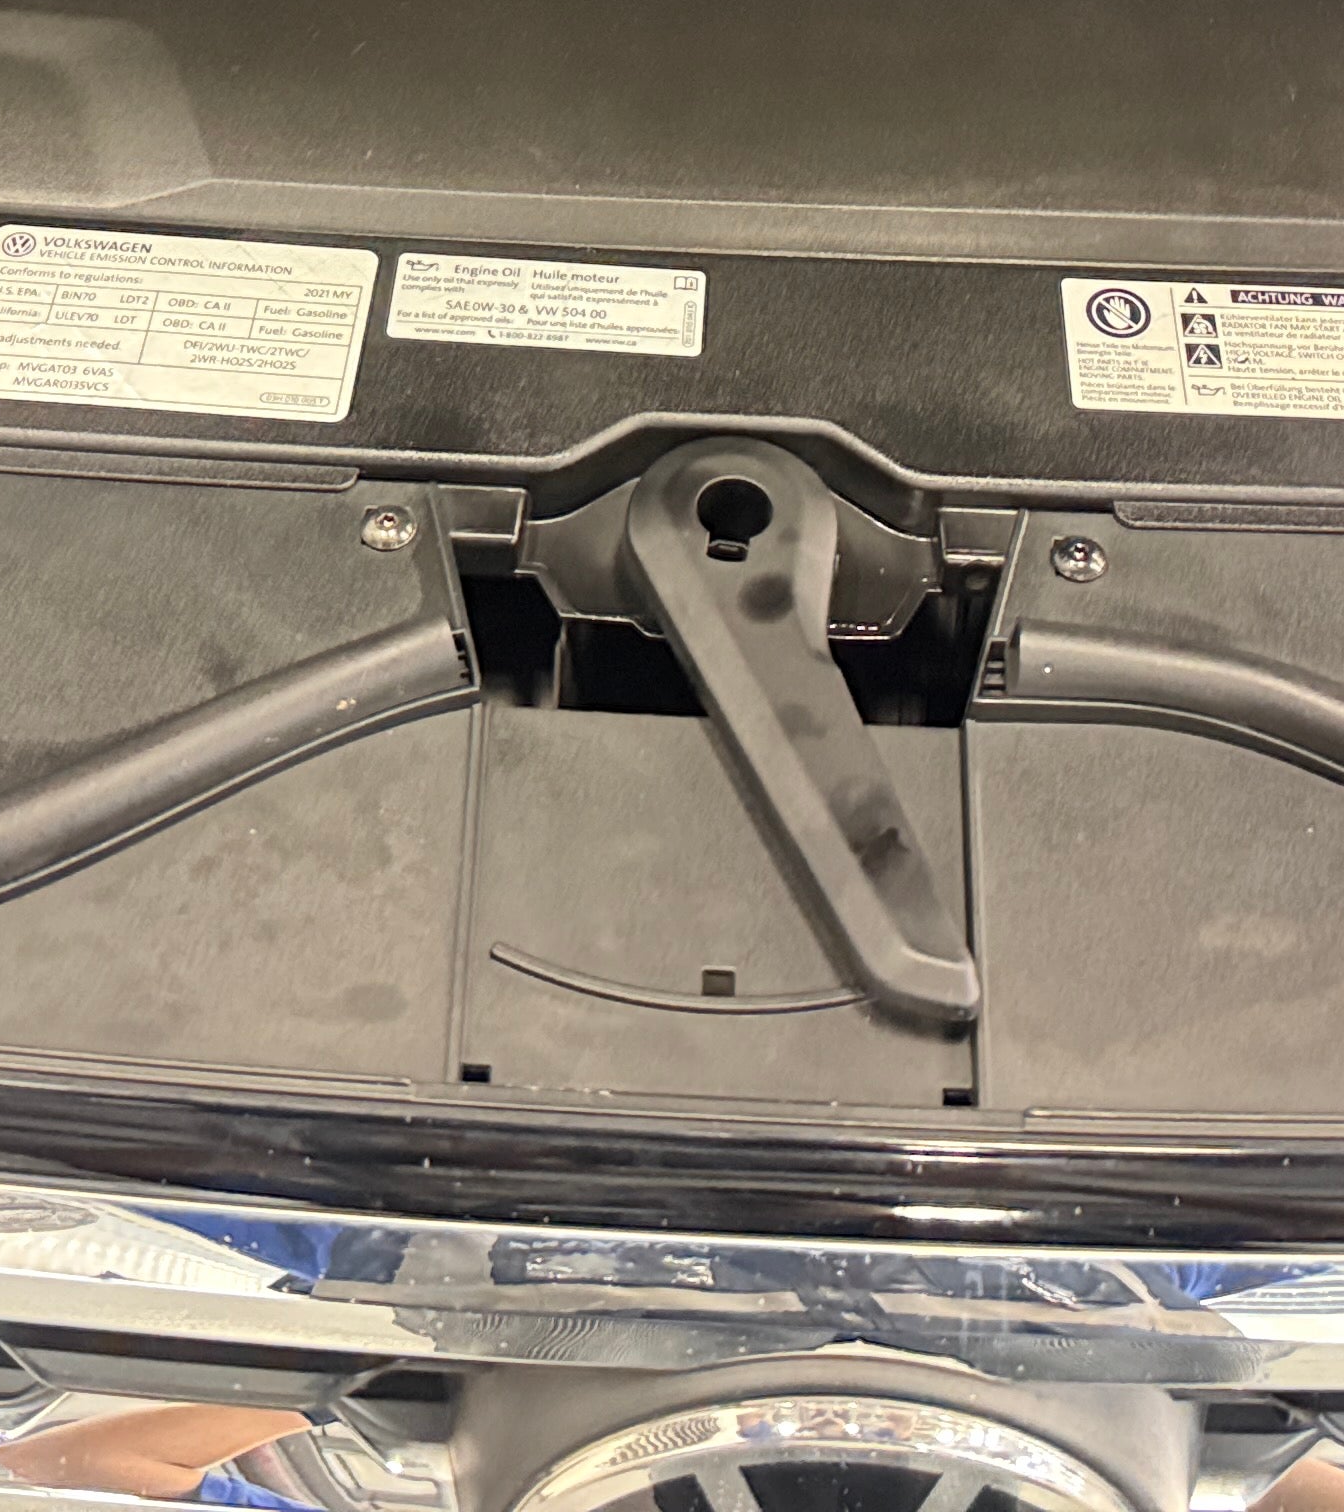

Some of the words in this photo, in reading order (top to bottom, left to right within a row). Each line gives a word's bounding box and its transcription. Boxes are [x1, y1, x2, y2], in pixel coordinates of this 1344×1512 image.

[44, 236, 153, 254] VOLKSWAGEN
[39, 248, 86, 262] VEHICLE
[88, 252, 148, 266] EMISSION
[149, 255, 206, 270] CONTROL
[207, 259, 294, 276] INFORMATION
[0, 266, 57, 281] Conforms
[59, 269, 72, 280] to
[73, 272, 144, 286] regulations:
[454, 265, 499, 278] Engine
[502, 267, 522, 278] Oil
[533, 269, 568, 281] Huile
[571, 272, 620, 284] moteur
[402, 274, 421, 282] Use
[423, 275, 442, 285] only
[443, 276, 455, 284] oil
[455, 277, 475, 285] that
[476, 278, 520, 290] expressly
[444, 285, 465, 294] with
[61, 290, 97, 302] BIN70
[119, 294, 150, 306] LDT2
[304, 288, 330, 299] 2021
[332, 290, 354, 300] MY
[529, 292, 546, 301] qui
[626, 288, 638, 297] de
[1237, 291, 1314, 306] ACHTUNG
[167, 297, 199, 309] OBD:
[203, 301, 221, 312] CA
[518, 304, 530, 316] &
[536, 305, 560, 318] VW
[561, 307, 587, 319] 504
[589, 309, 608, 320] 00
[54, 310, 99, 323] ULEV70
[263, 304, 291, 317] Fuel:
[296, 308, 349, 321] Gasoline
[397, 309, 413, 319] For
[422, 311, 436, 320] list
[437, 312, 448, 321] of
[449, 314, 493, 325] approved
[113, 315, 137, 326] LDT
[162, 317, 194, 330] OBD:
[198, 321, 215, 332] CA
[527, 318, 548, 328] Pour
[550, 320, 567, 329] une
[569, 319, 587, 329] liste
[258, 324, 287, 337] Fuel:
[292, 327, 345, 341] Gasoline
